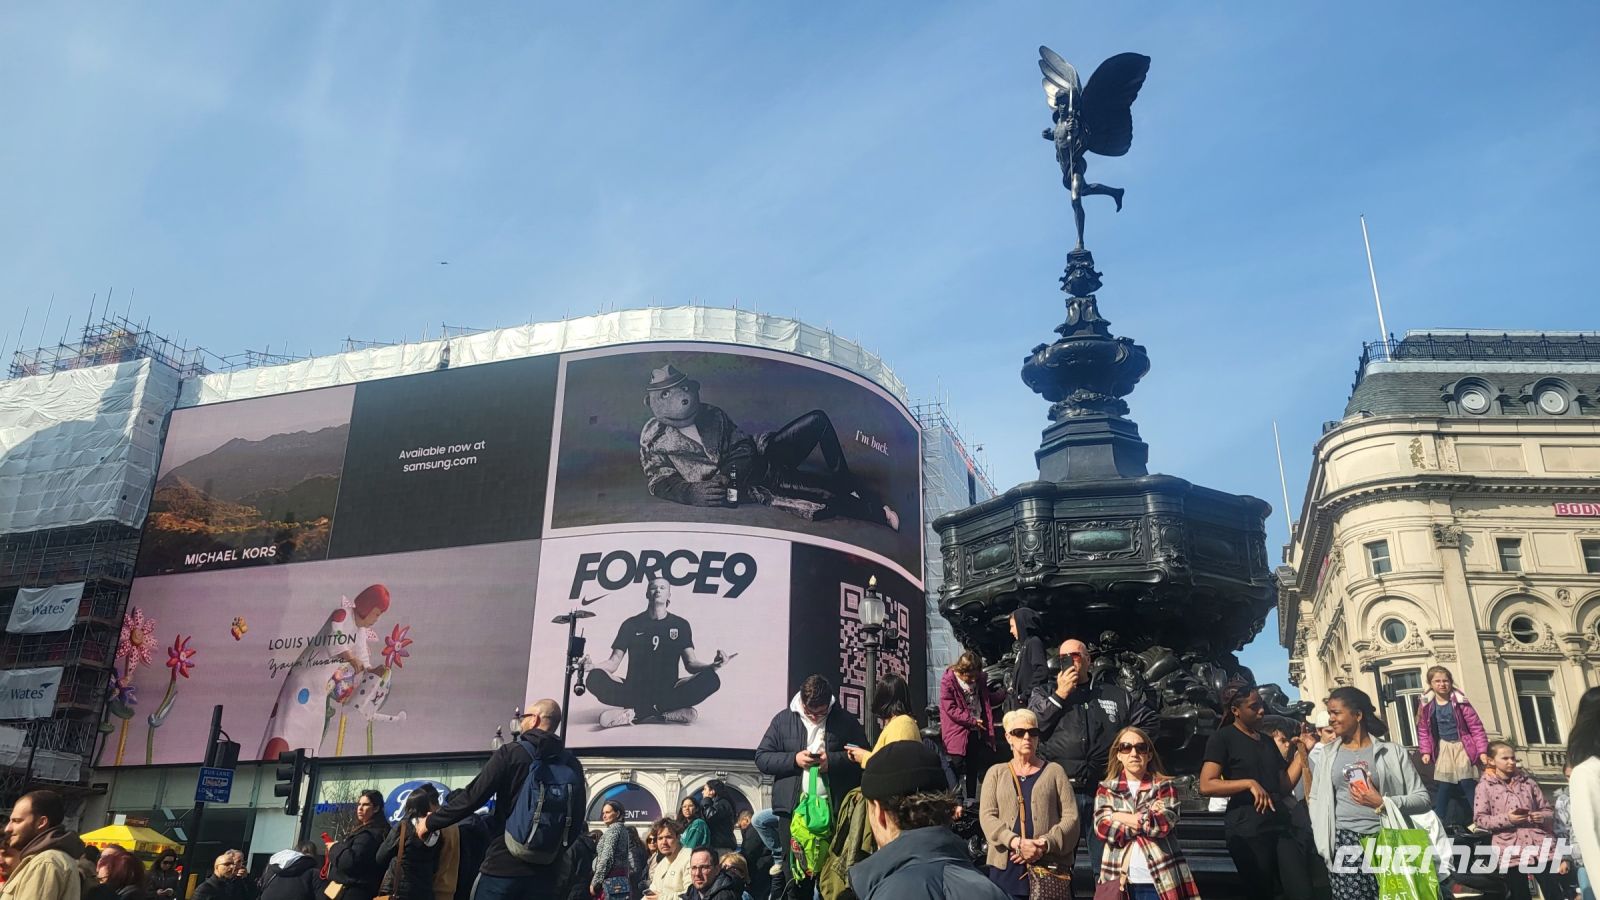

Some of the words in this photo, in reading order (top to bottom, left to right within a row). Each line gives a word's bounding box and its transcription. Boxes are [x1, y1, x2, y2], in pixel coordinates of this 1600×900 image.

[398, 445, 446, 460] Available
[447, 442, 472, 454] now
[473, 439, 486, 450] at
[855, 429, 870, 446] I'm
[870, 435, 889, 456] back.
[402, 456, 477, 472] samsung.com
[184, 549, 238, 566] MICHAEL
[242, 545, 277, 560] KORS
[568, 549, 758, 600] FORCE9
[32, 604, 66, 616] Wates
[268, 637, 303, 651] LOUIS
[306, 633, 357, 648] VUITTON
[652, 636, 660, 651] 9
[11, 688, 45, 700] Wates
